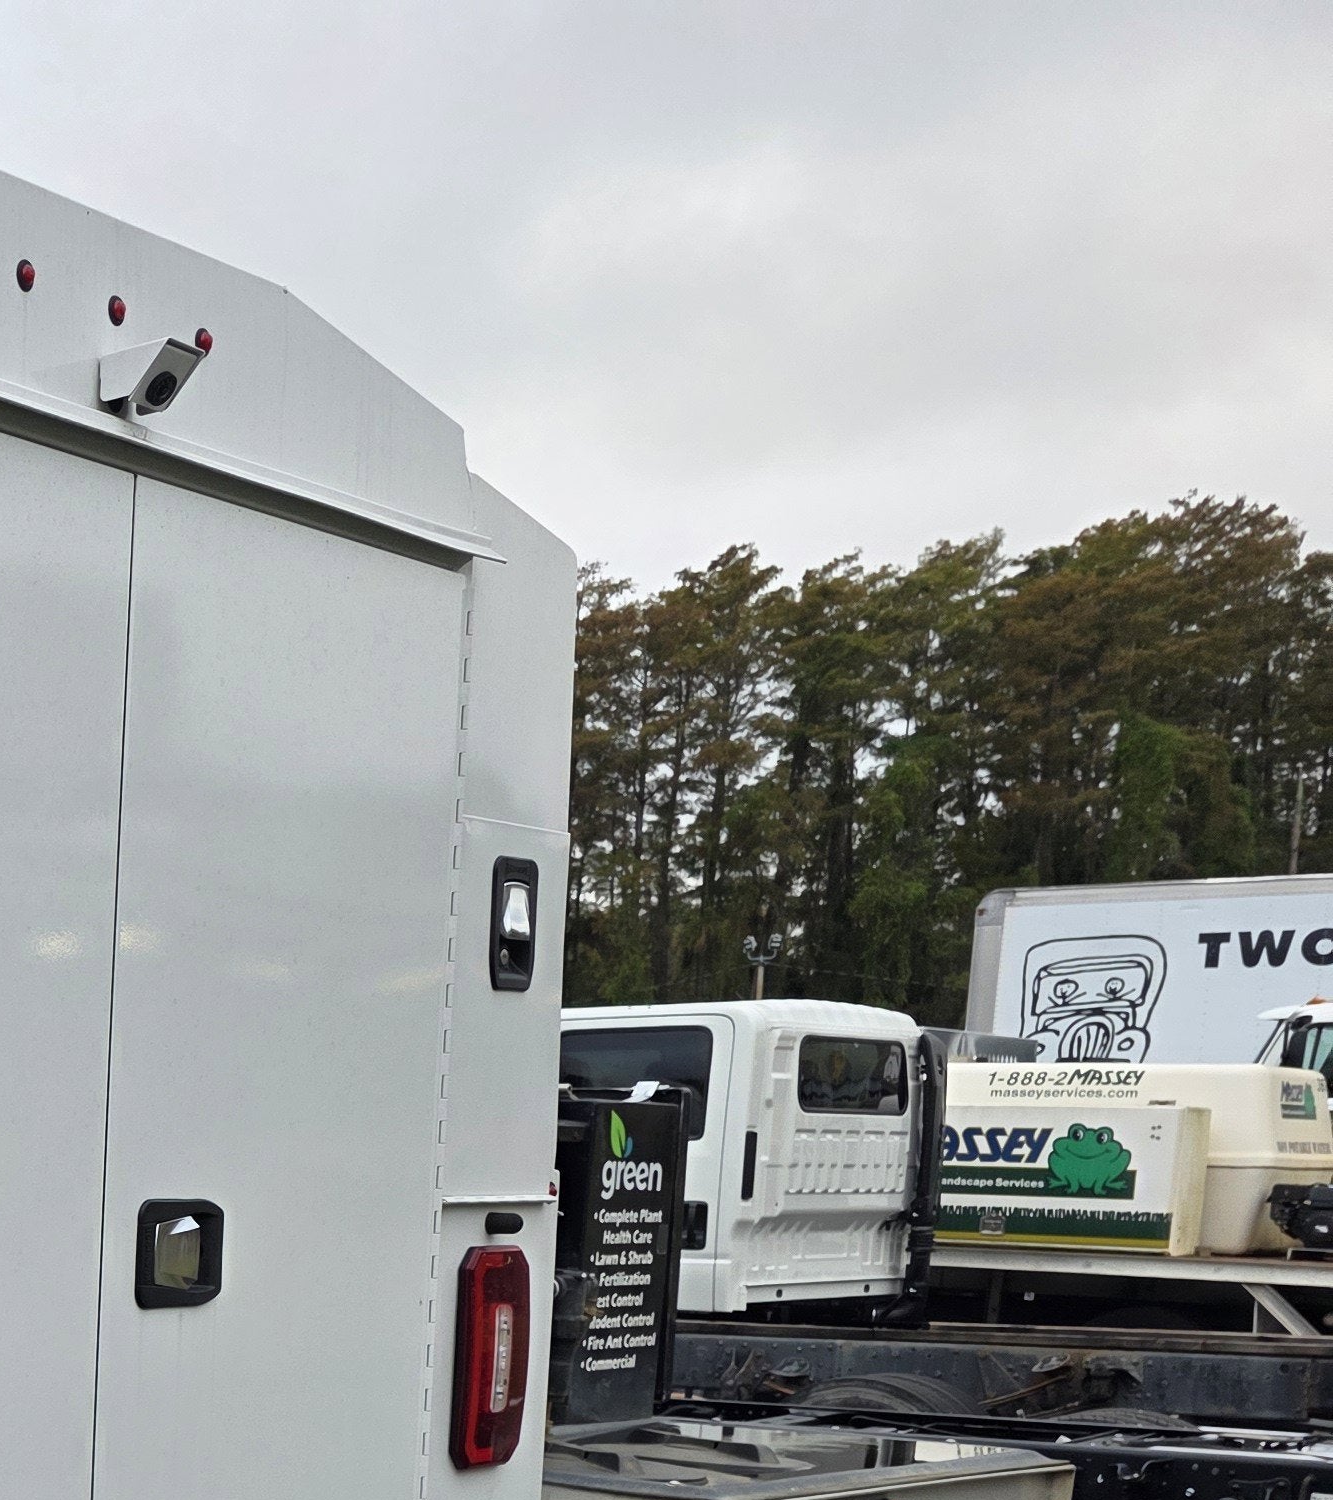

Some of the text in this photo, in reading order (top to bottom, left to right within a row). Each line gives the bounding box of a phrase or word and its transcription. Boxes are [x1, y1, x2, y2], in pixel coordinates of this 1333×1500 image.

[1198, 928, 1333, 969] TWO
[989, 1069, 1145, 1086] 1-888-2MASSEY
[990, 1087, 1139, 1098] masseyservices.com
[942, 1125, 1054, 1164] ASSEY
[600, 1160, 663, 1200] green
[941, 1176, 1045, 1189] andscape Services
[598, 1208, 663, 1227] Complete Plant
[602, 1229, 653, 1244] Health Care
[595, 1250, 654, 1266] Lawn & Shrub
[598, 1271, 651, 1287] Fertilization
[595, 1291, 644, 1308] est Control
[621, 1311, 655, 1328] Control
[586, 1331, 657, 1351] Fire Ant Control
[585, 1354, 637, 1372] Commercial
